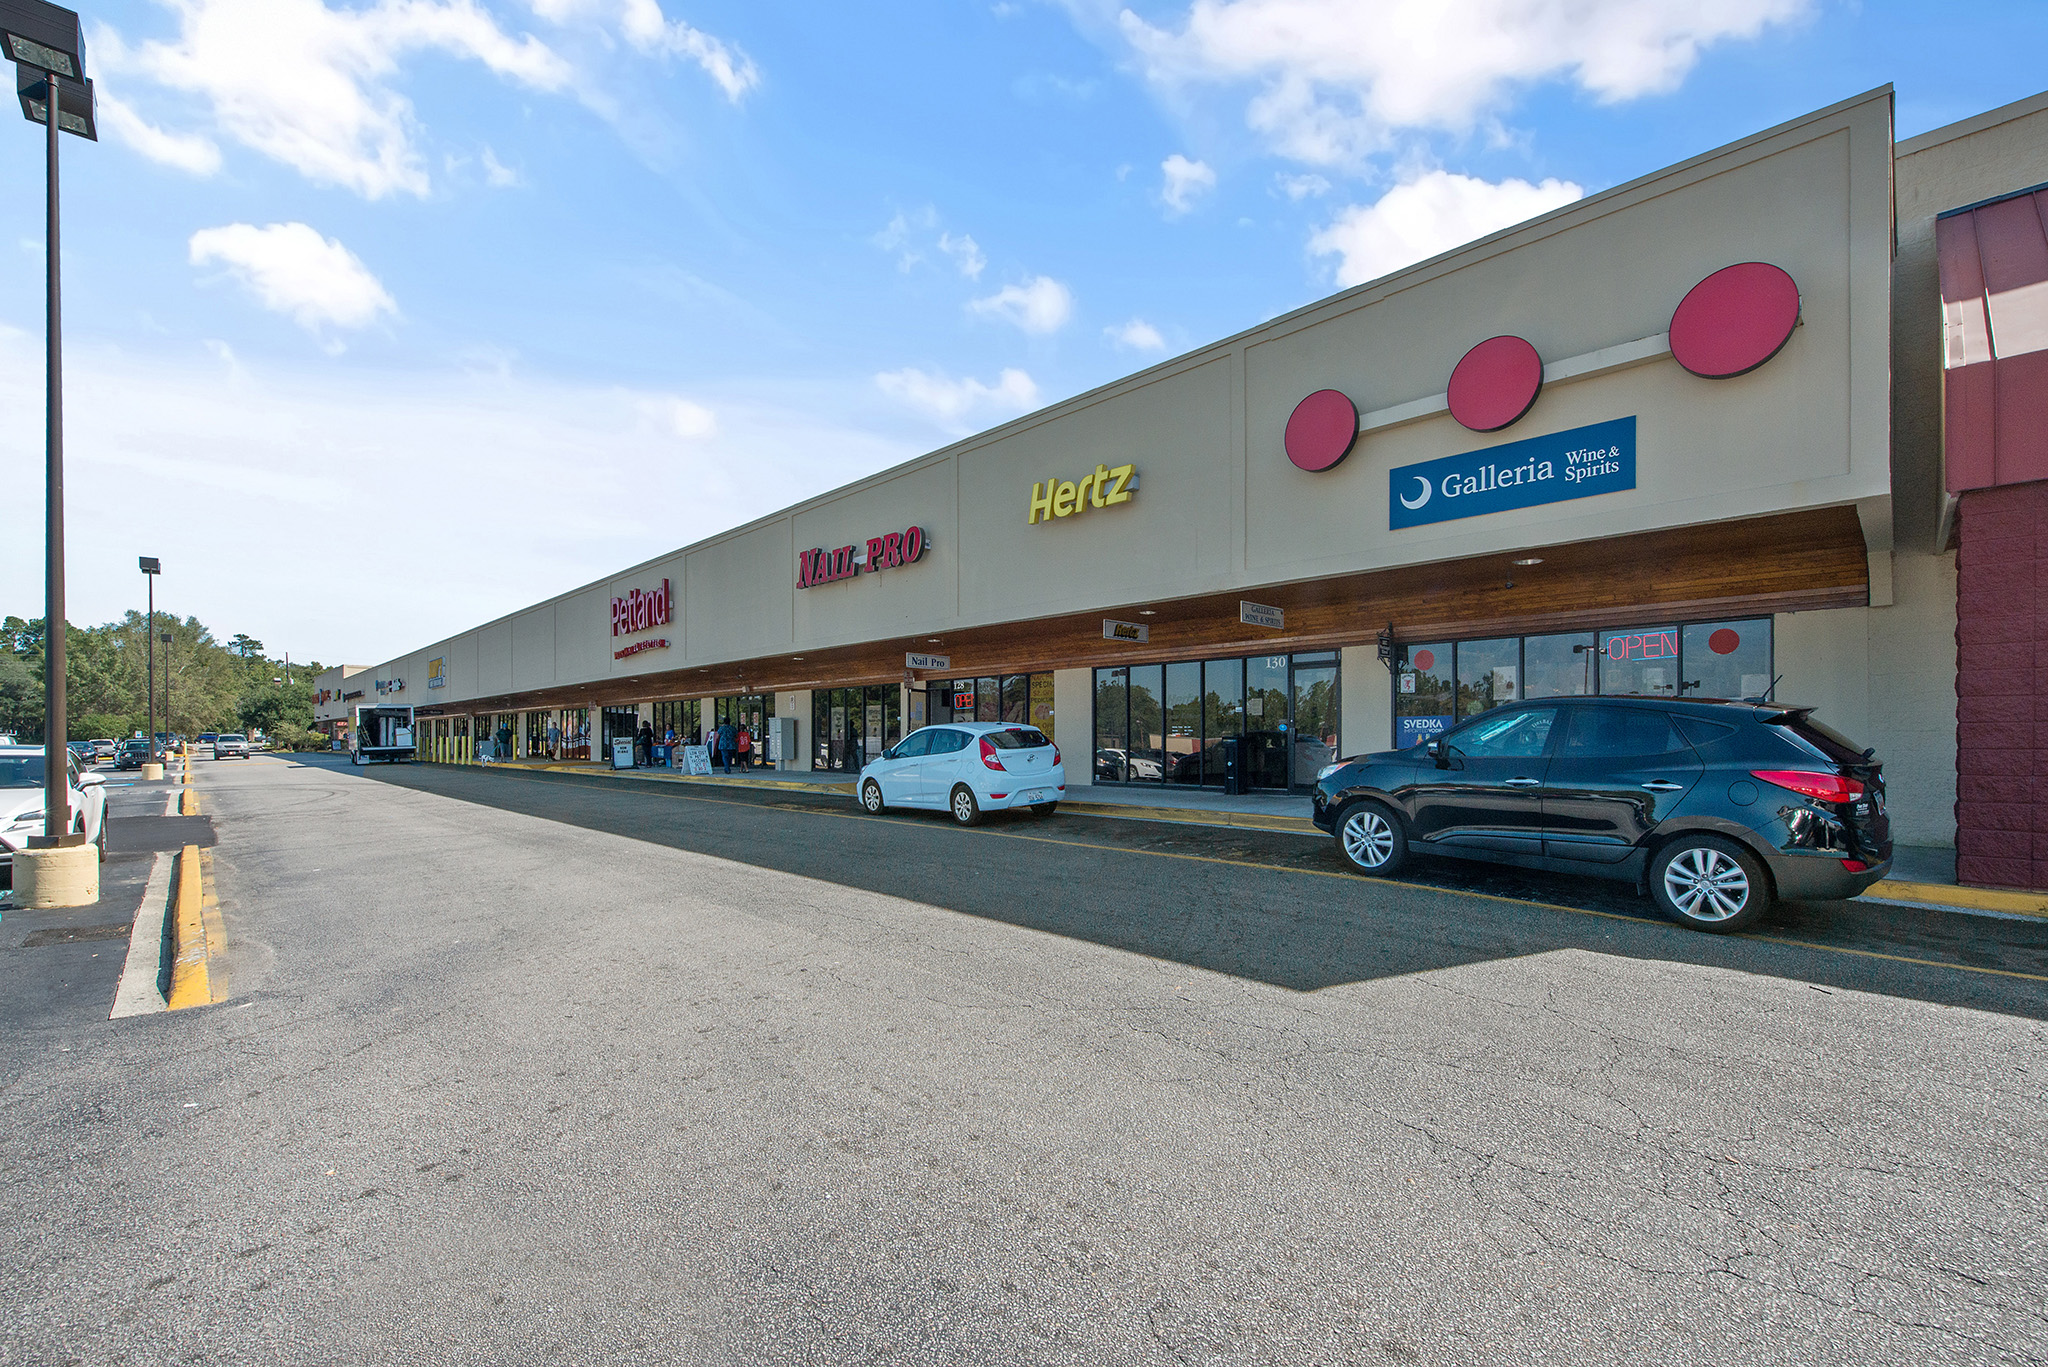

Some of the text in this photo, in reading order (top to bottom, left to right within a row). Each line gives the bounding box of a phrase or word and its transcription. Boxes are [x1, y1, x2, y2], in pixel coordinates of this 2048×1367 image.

[1565, 445, 1620, 465] Wine &
[1441, 457, 1554, 498] Galleria
[1565, 460, 1620, 483] Spirits
[1028, 464, 1136, 525] Hertz
[796, 525, 926, 589] NAIL PRO
[611, 578, 669, 636] Petland
[1251, 606, 1275, 616] GALLERIA
[1245, 613, 1258, 622] WINE
[1113, 623, 1141, 640] Hertz
[1609, 632, 1678, 660] OPEN
[911, 656, 945, 668] Nail Pro
[1265, 656, 1286, 669] 130
[953, 681, 965, 690] 128
[1403, 719, 1443, 729] SVEDKA
